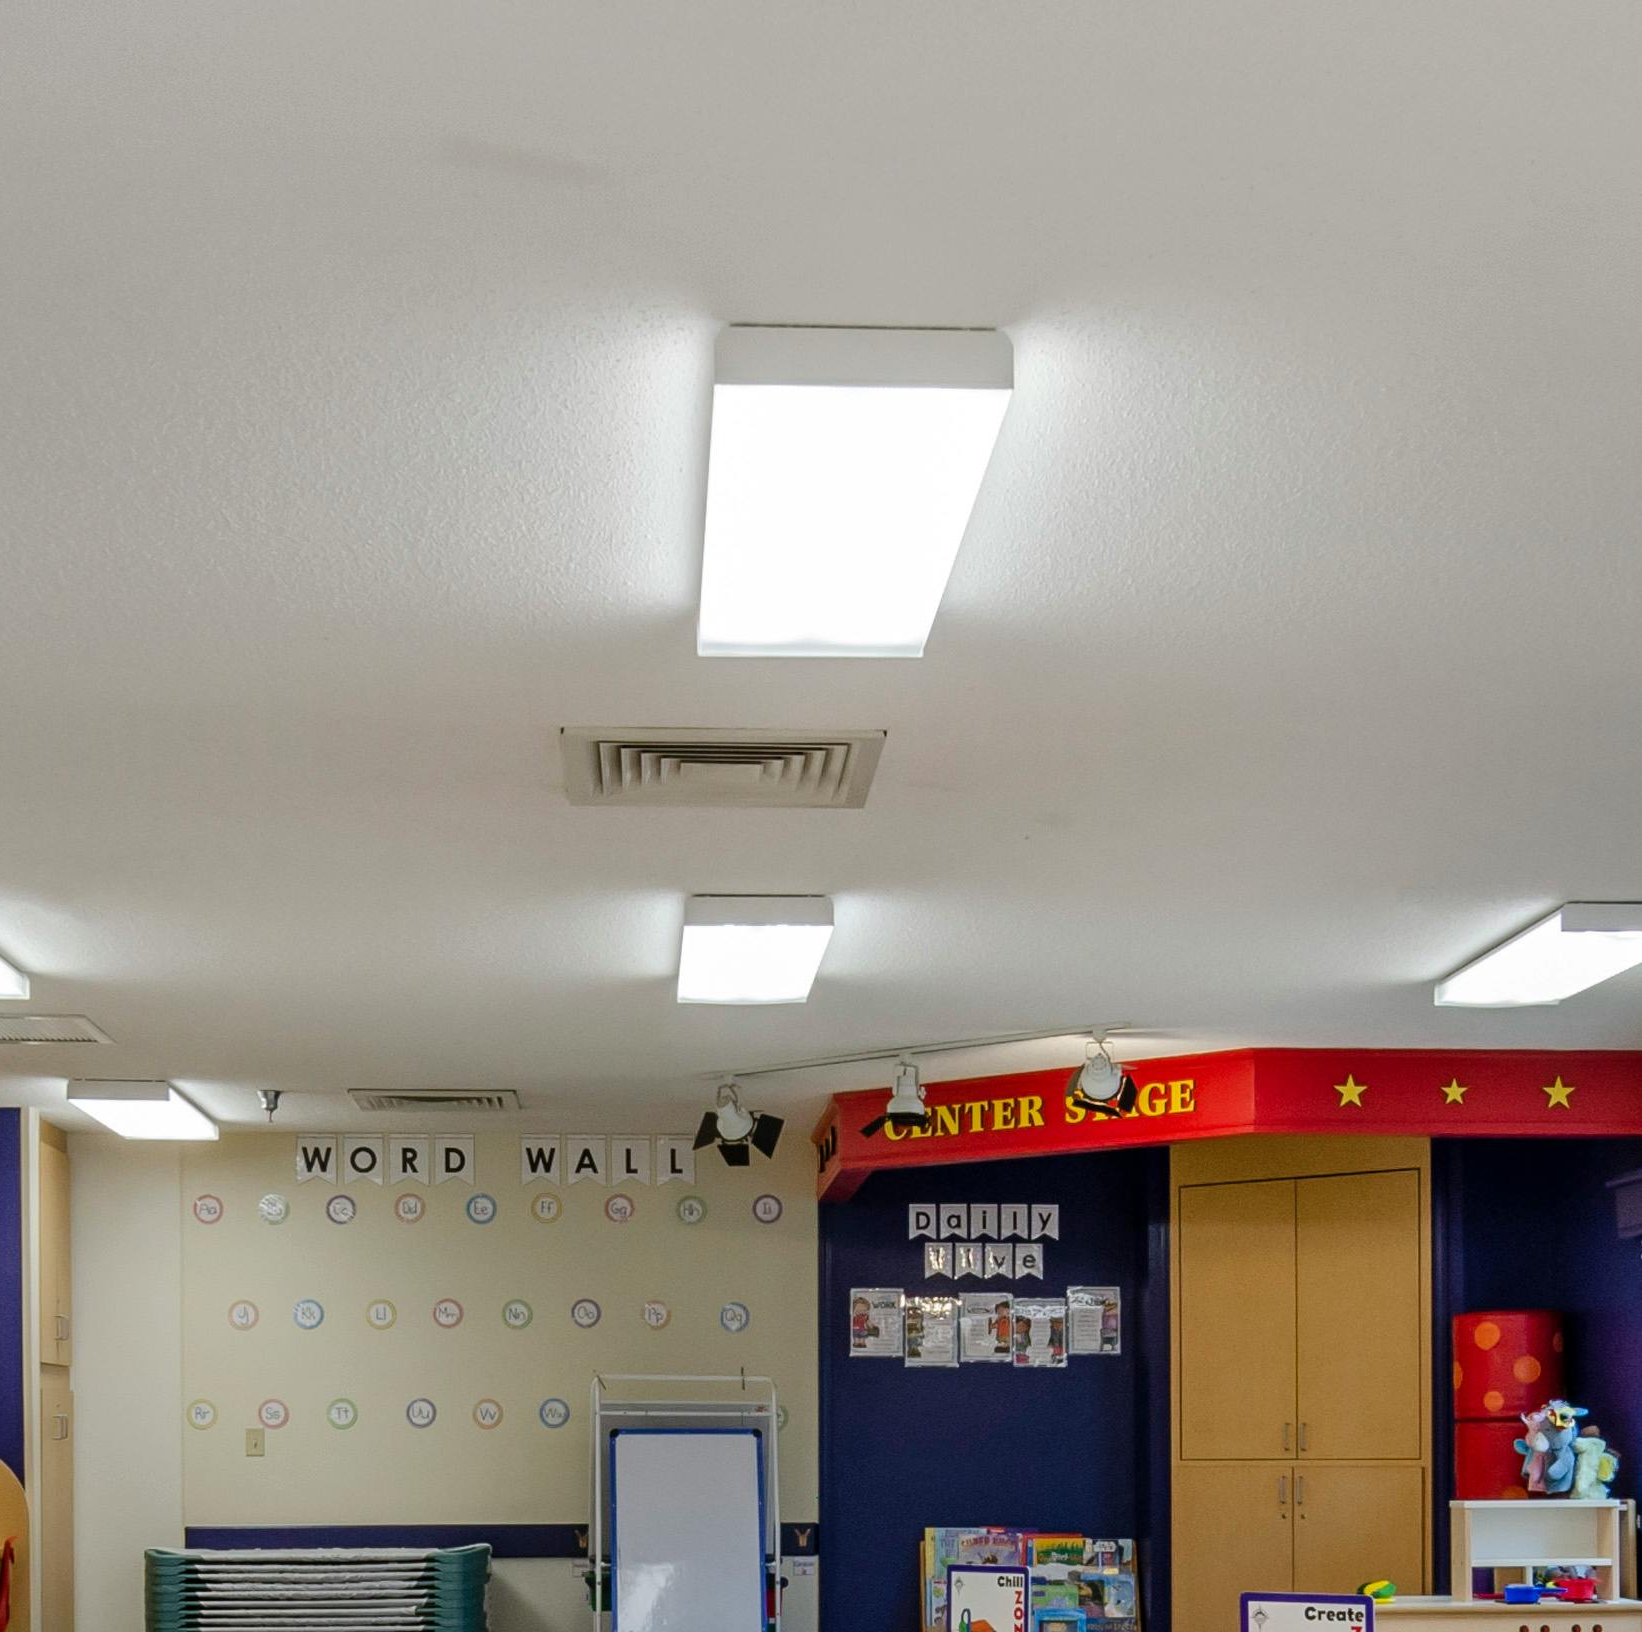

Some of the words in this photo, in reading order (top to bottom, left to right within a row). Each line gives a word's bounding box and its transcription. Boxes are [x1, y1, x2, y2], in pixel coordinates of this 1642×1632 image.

[1064, 1079, 1196, 1124] SGE
[302, 1146, 466, 1174] WORD
[526, 1147, 684, 1174] WALL
[915, 1211, 1052, 1230] Daily
[997, 1576, 1023, 1588] Chill
[1304, 1606, 1365, 1624] Create
